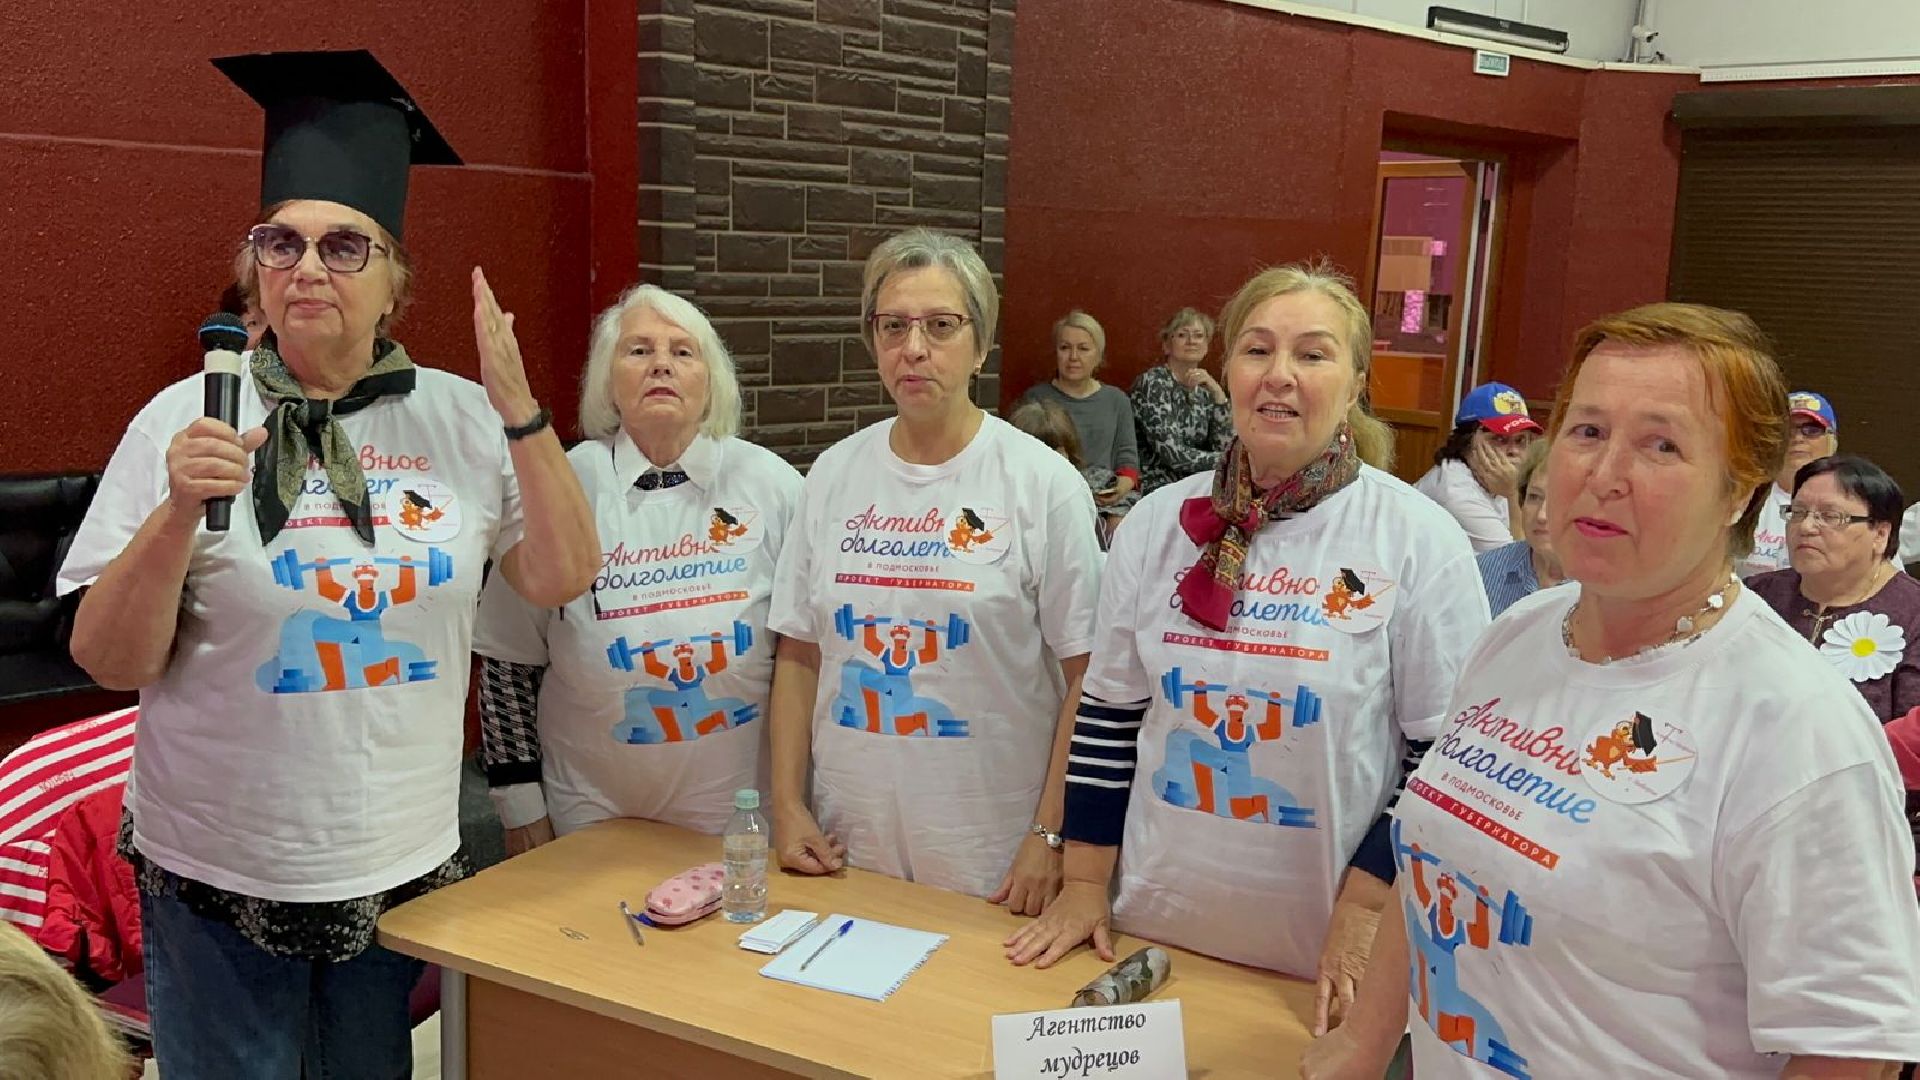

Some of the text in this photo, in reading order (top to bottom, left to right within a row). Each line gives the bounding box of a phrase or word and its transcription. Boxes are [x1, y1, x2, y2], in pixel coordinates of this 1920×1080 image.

[601, 533, 720, 568] Активн
[840, 529, 950, 558] долголет
[595, 557, 748, 591] долголетие
[1225, 642, 1327, 660] ГУБЕРНАТОРА
[1436, 723, 1598, 824] долголетие
[1450, 803, 1551, 868] ГУБЕРНАТОРА
[1026, 1013, 1147, 1041] Агентство
[1040, 1046, 1141, 1079] мудрецов
